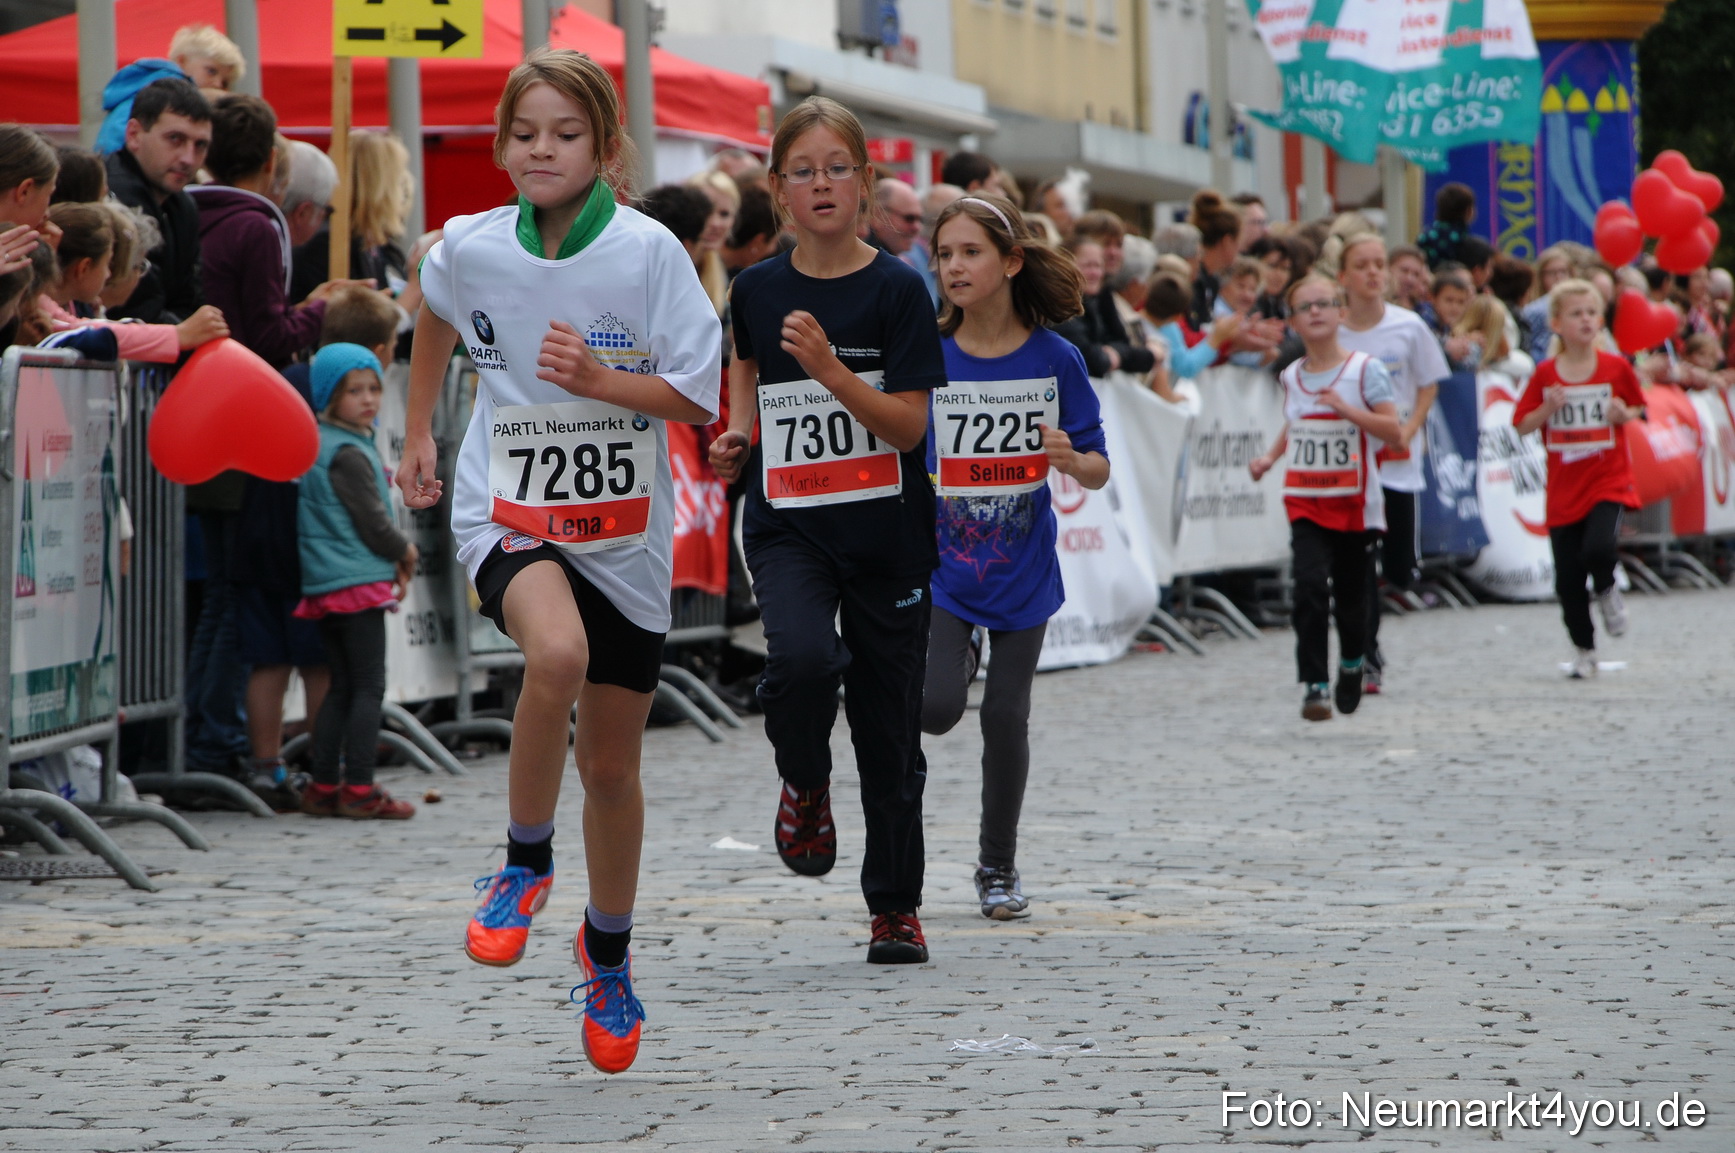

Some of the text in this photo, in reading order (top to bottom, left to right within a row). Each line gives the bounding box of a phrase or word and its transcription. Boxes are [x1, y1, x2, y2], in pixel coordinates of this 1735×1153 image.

[470, 346, 506, 362] PARTL
[588, 348, 613, 356] arkter
[763, 395, 802, 410] PARTL
[936, 392, 1039, 405] PARTL Neumarkt
[493, 417, 624, 437] PARTL Neumarkt
[947, 410, 1044, 454] 7225
[1293, 438, 1350, 466] 7013
[508, 441, 636, 501] 7285
[969, 463, 1026, 482] Selina
[640, 485, 649, 494] W
[779, 471, 830, 494] Marike
[547, 514, 602, 536] Lena
[895, 595, 917, 608] JAKO
